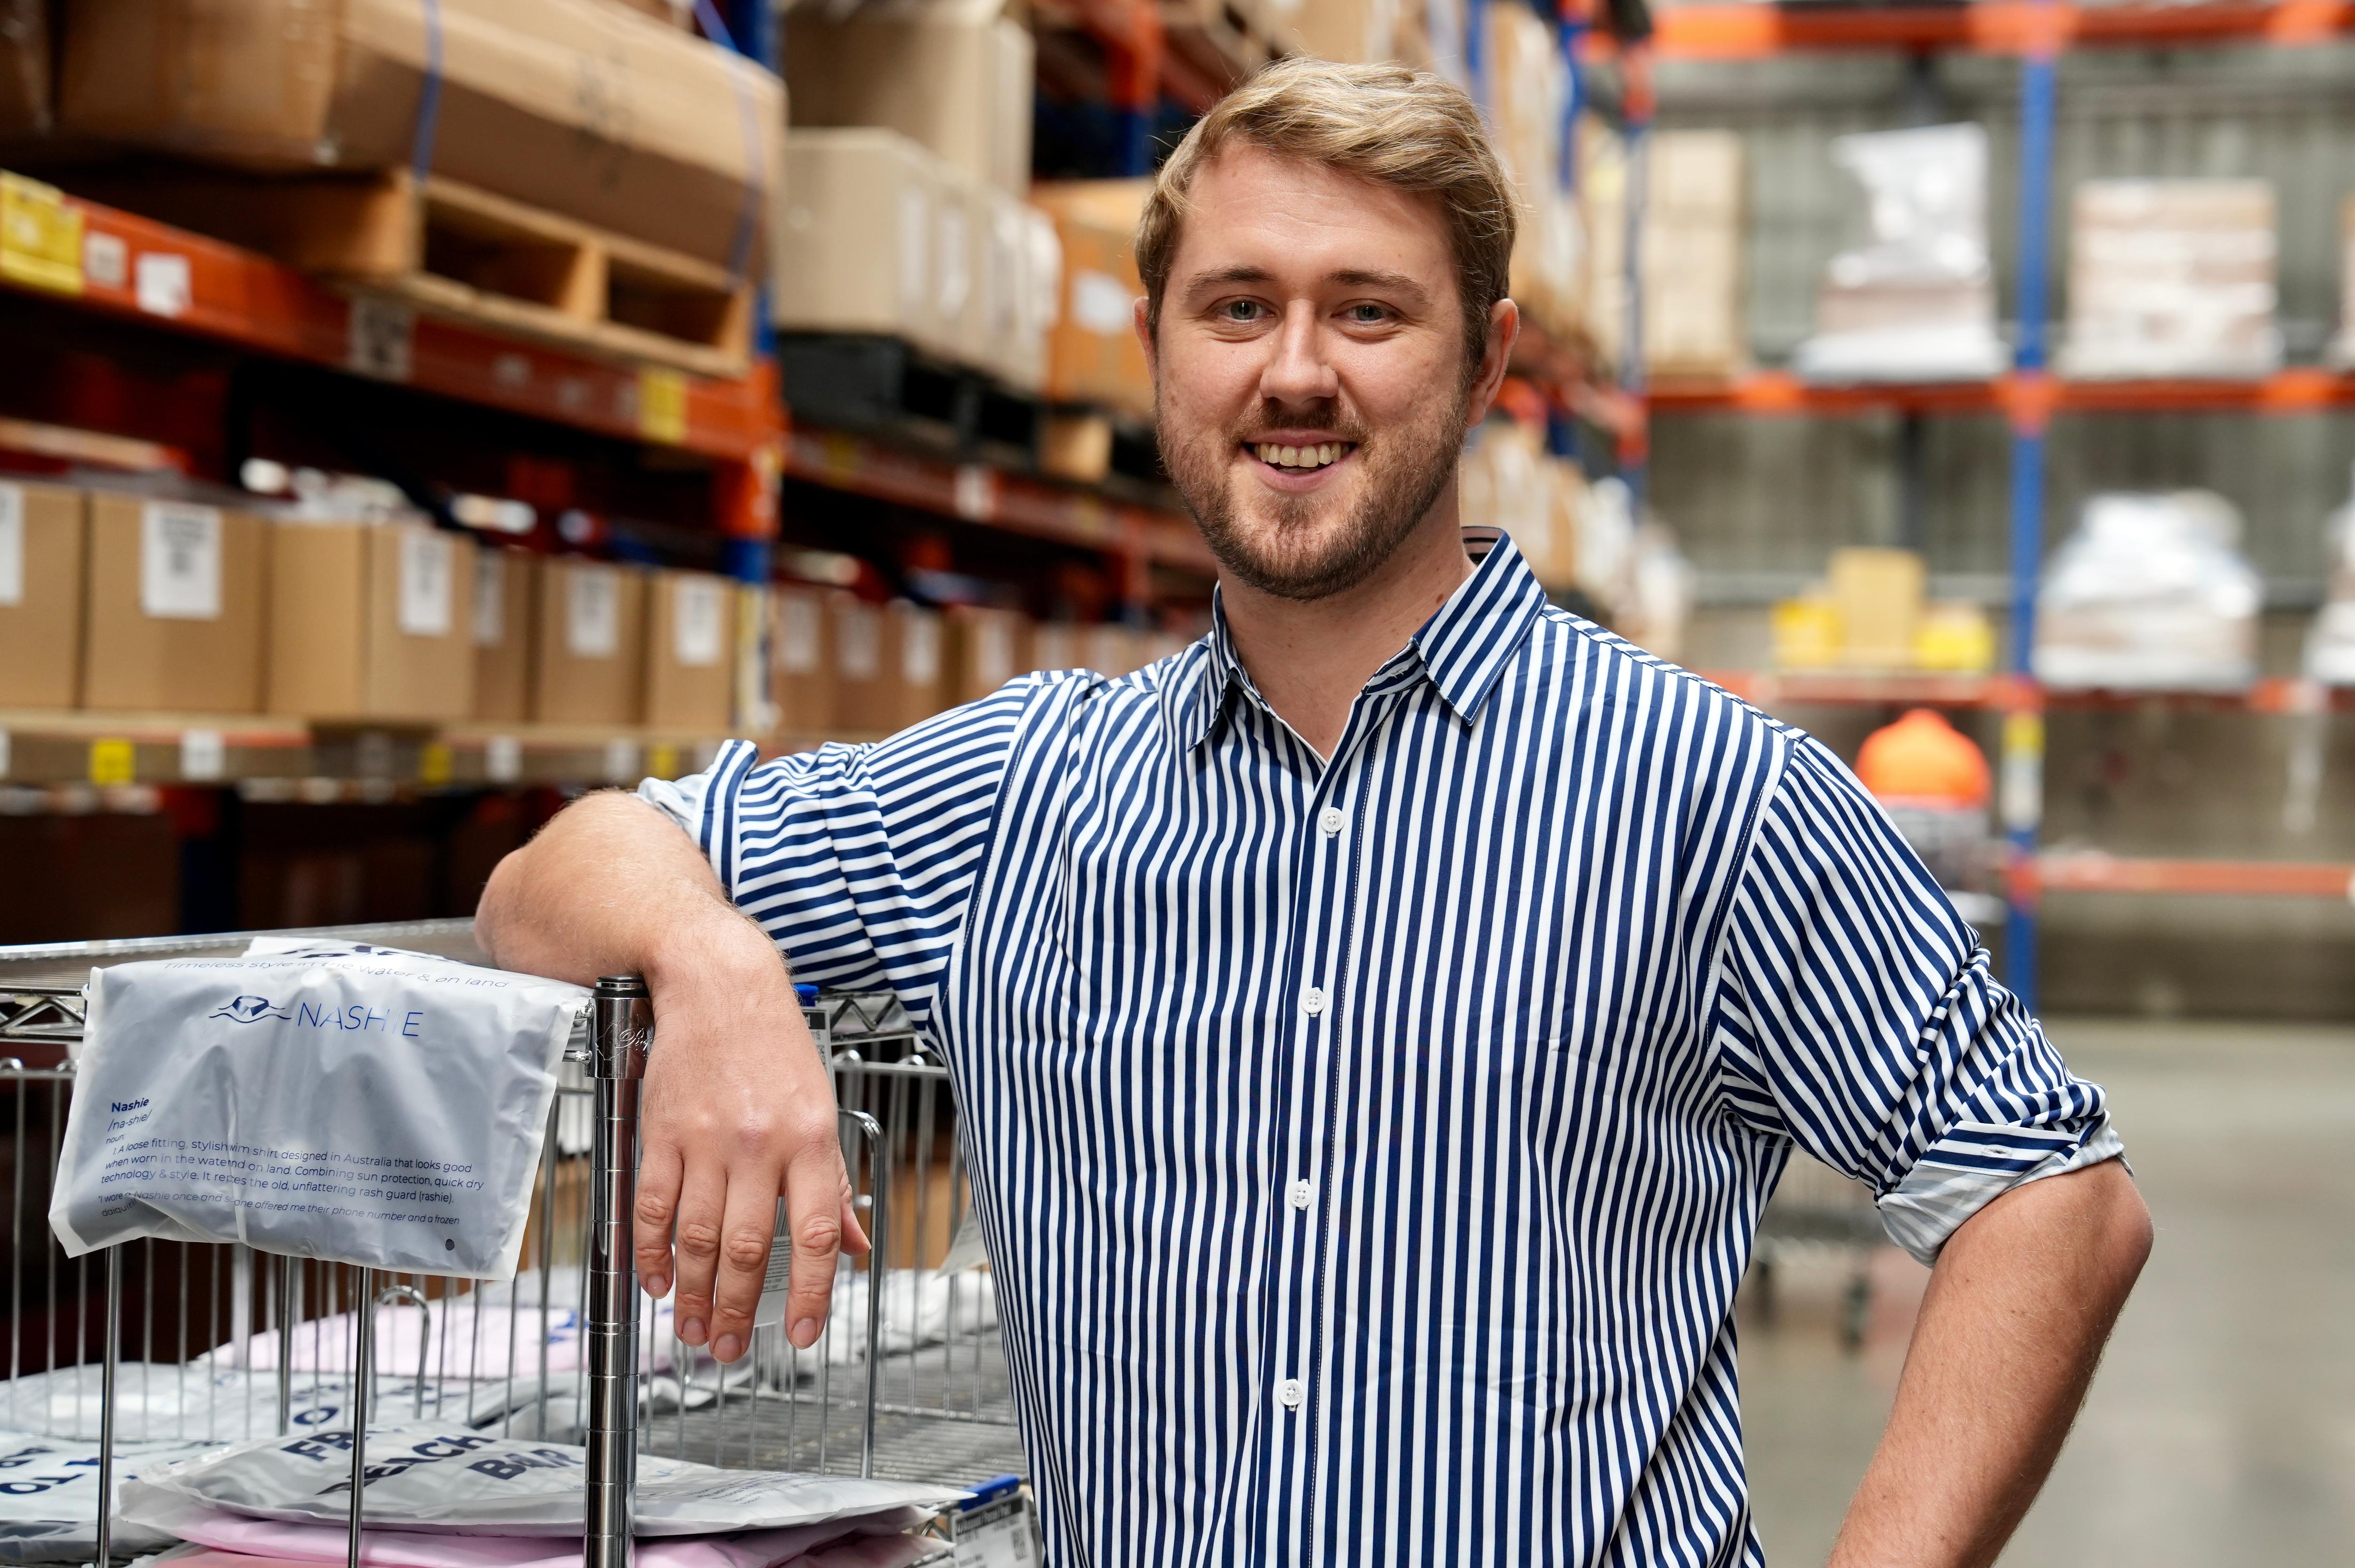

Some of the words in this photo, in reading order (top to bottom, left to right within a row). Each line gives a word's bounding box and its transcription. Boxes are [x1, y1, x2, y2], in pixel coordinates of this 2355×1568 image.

[417, 974, 430, 982] &
[464, 977, 510, 988] land
[298, 1002, 423, 1037] NASHIE
[107, 1109, 153, 1132] /na-shie/
[111, 1097, 149, 1112] Nashie
[106, 1157, 129, 1170] when
[131, 1154, 157, 1163] worn
[161, 1153, 171, 1163] in
[175, 1154, 195, 1163] the
[248, 1163, 263, 1172] on
[267, 1163, 292, 1175] land.
[295, 1166, 354, 1181] Combining
[357, 1172, 378, 1181] sun
[381, 1174, 432, 1186] protection,
[434, 1177, 464, 1188] quick
[466, 1179, 484, 1191] dry
[118, 1145, 124, 1154] A
[126, 1141, 149, 1151] loose
[151, 1138, 188, 1150] fitting,
[192, 1140, 227, 1152] stylish
[252, 1148, 279, 1159] shirt
[281, 1150, 328, 1162] designed
[330, 1152, 341, 1162] in
[343, 1154, 391, 1167] Australia
[394, 1157, 413, 1168] that
[415, 1159, 441, 1170] looks
[443, 1163, 472, 1173] good
[101, 1169, 156, 1184] technology
[159, 1169, 167, 1178] &
[170, 1170, 199, 1181] style.
[203, 1171, 211, 1181] It
[250, 1178, 268, 1188] the
[271, 1180, 289, 1192] old,
[292, 1181, 356, 1197] unflattering
[359, 1187, 383, 1198] rash
[386, 1190, 416, 1201] guard
[419, 1190, 455, 1204] (rashie).
[104, 1193, 123, 1202] wore
[134, 1190, 171, 1201] Nashie
[200, 1194, 223, 1202] and
[254, 1200, 290, 1211] offered
[290, 1204, 306, 1212] me
[307, 1204, 331, 1214] their
[331, 1206, 365, 1218] phone
[366, 1211, 406, 1221] number
[407, 1214, 427, 1222] and
[434, 1214, 460, 1225] frozen
[465, 1448, 585, 1480] BAR
